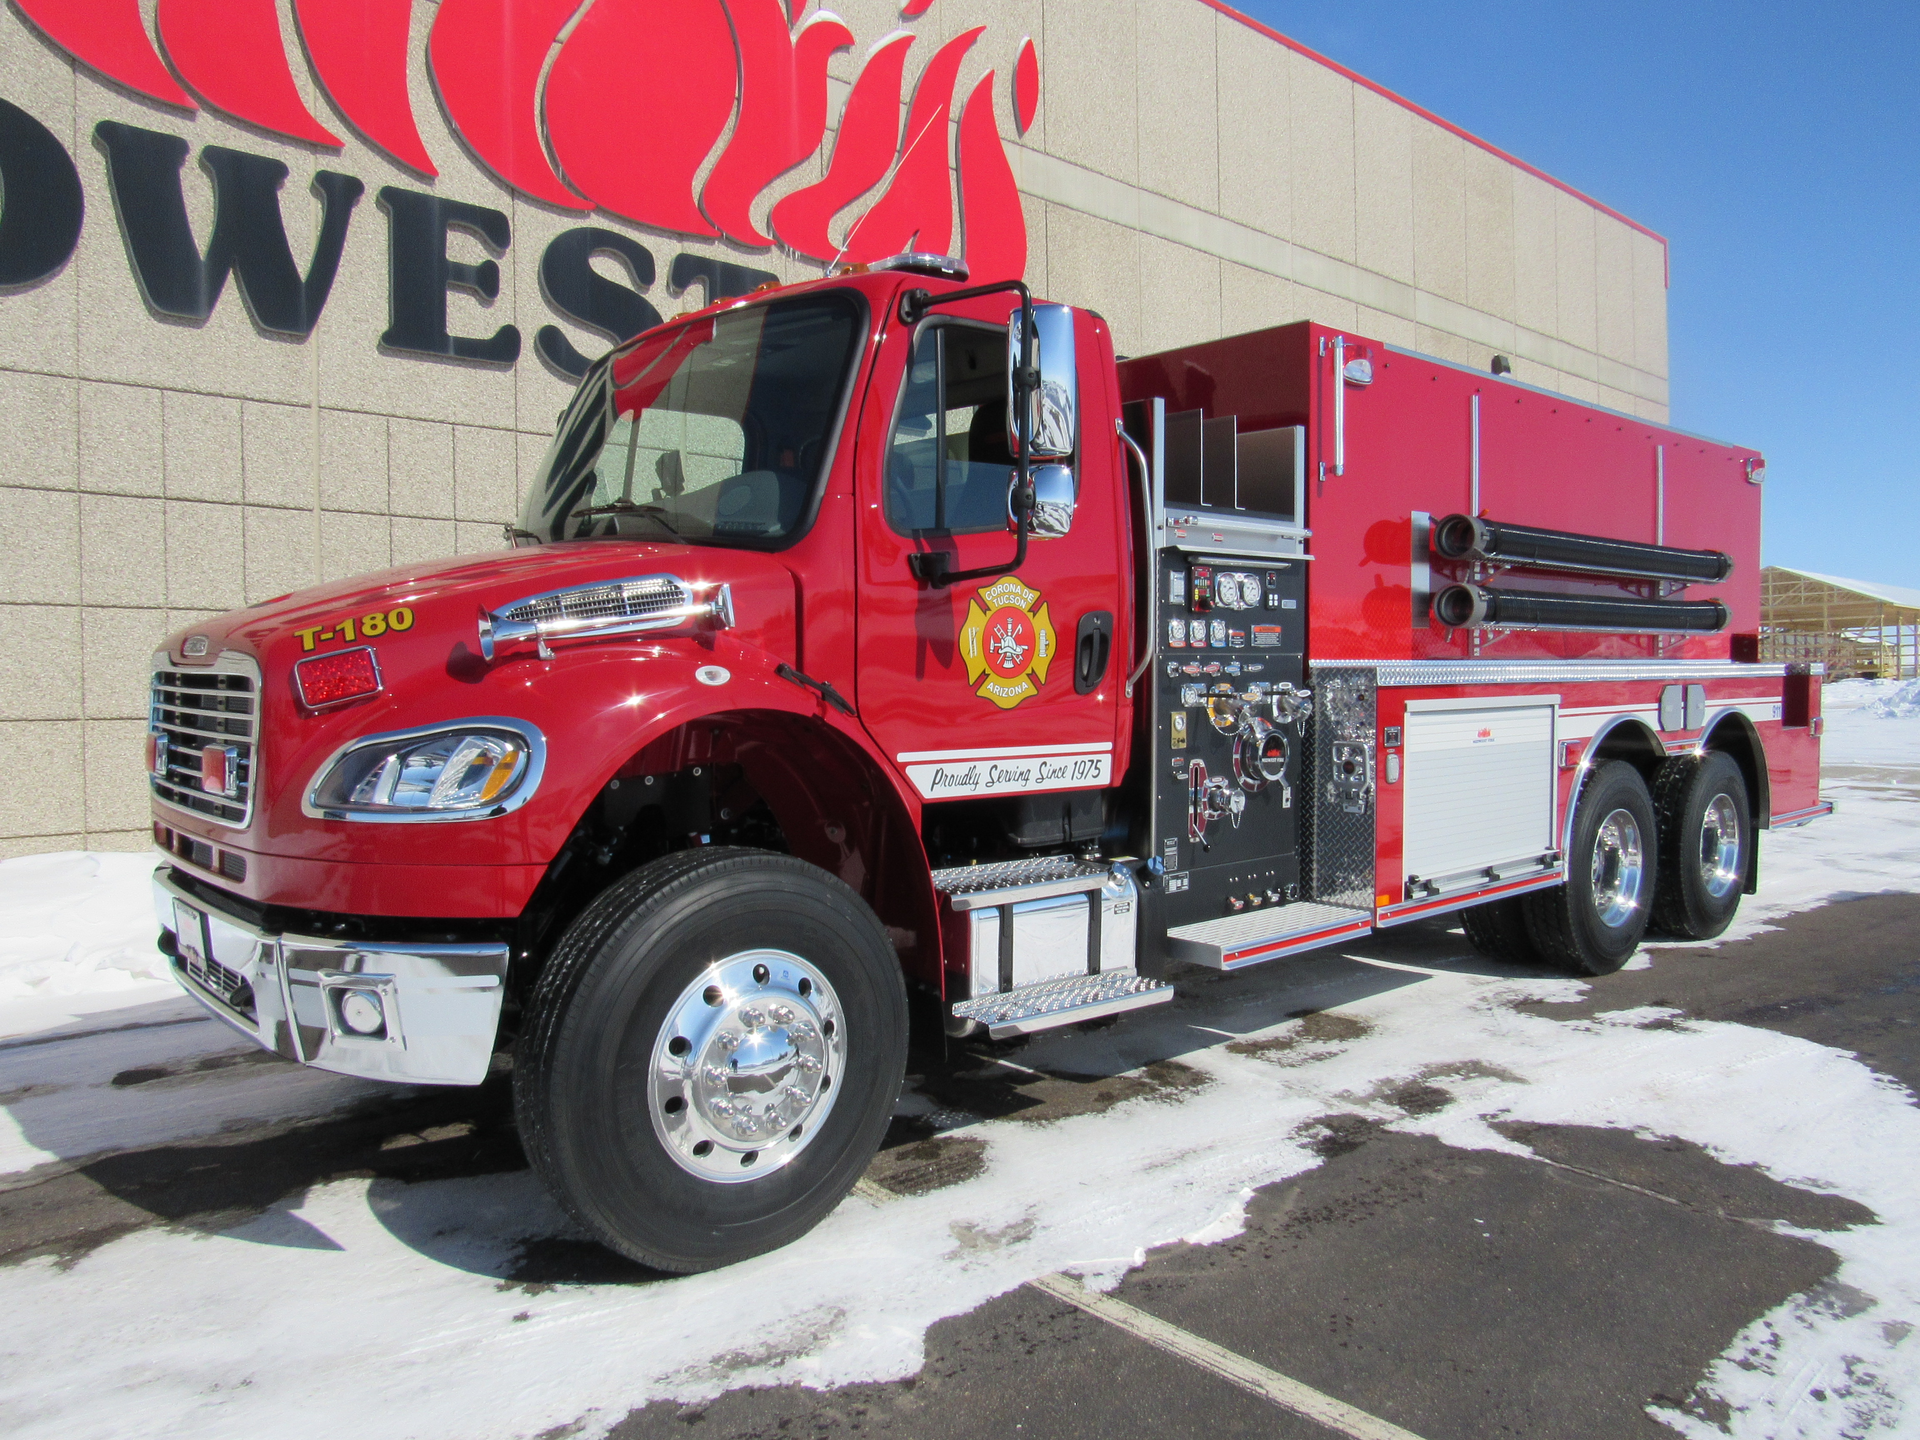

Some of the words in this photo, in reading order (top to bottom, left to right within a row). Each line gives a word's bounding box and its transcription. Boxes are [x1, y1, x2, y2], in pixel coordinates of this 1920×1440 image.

[985, 583, 1021, 601] CORONA
[1022, 588, 1035, 603] DE
[992, 594, 1027, 609] TUCSON
[293, 608, 413, 651] T-180
[986, 681, 1029, 698] ARIZONA
[930, 765, 981, 792] Proudly
[985, 764, 1031, 787] Serving
[1035, 761, 1068, 784] Since
[1071, 759, 1102, 781] 1975
